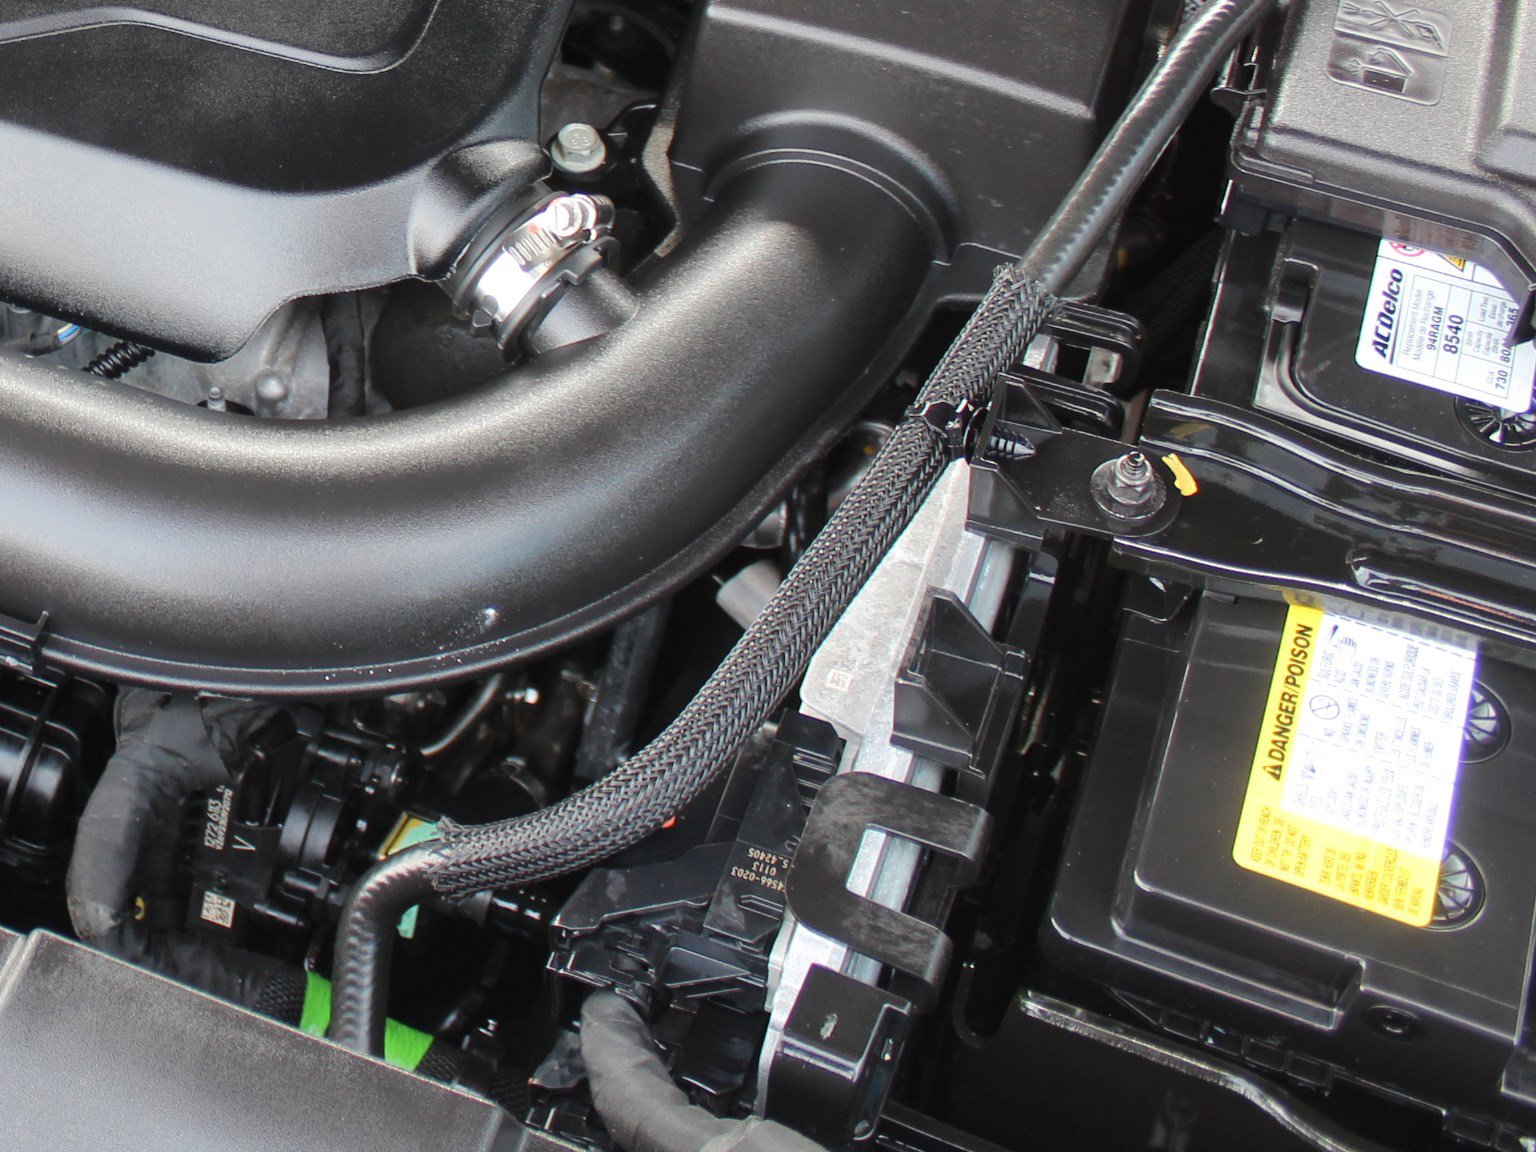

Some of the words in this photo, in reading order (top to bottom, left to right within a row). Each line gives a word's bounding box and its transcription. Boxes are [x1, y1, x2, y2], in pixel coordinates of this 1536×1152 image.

[1372, 268, 1404, 359] ACDelco
[1426, 306, 1444, 351] 94RAGM
[1443, 314, 1464, 355] 8540
[1495, 370, 1509, 390] 730
[1268, 623, 1314, 762] DANGER/POISON
[730, 866, 786, 892] 4566-0203
[752, 861, 777, 876] 0113
